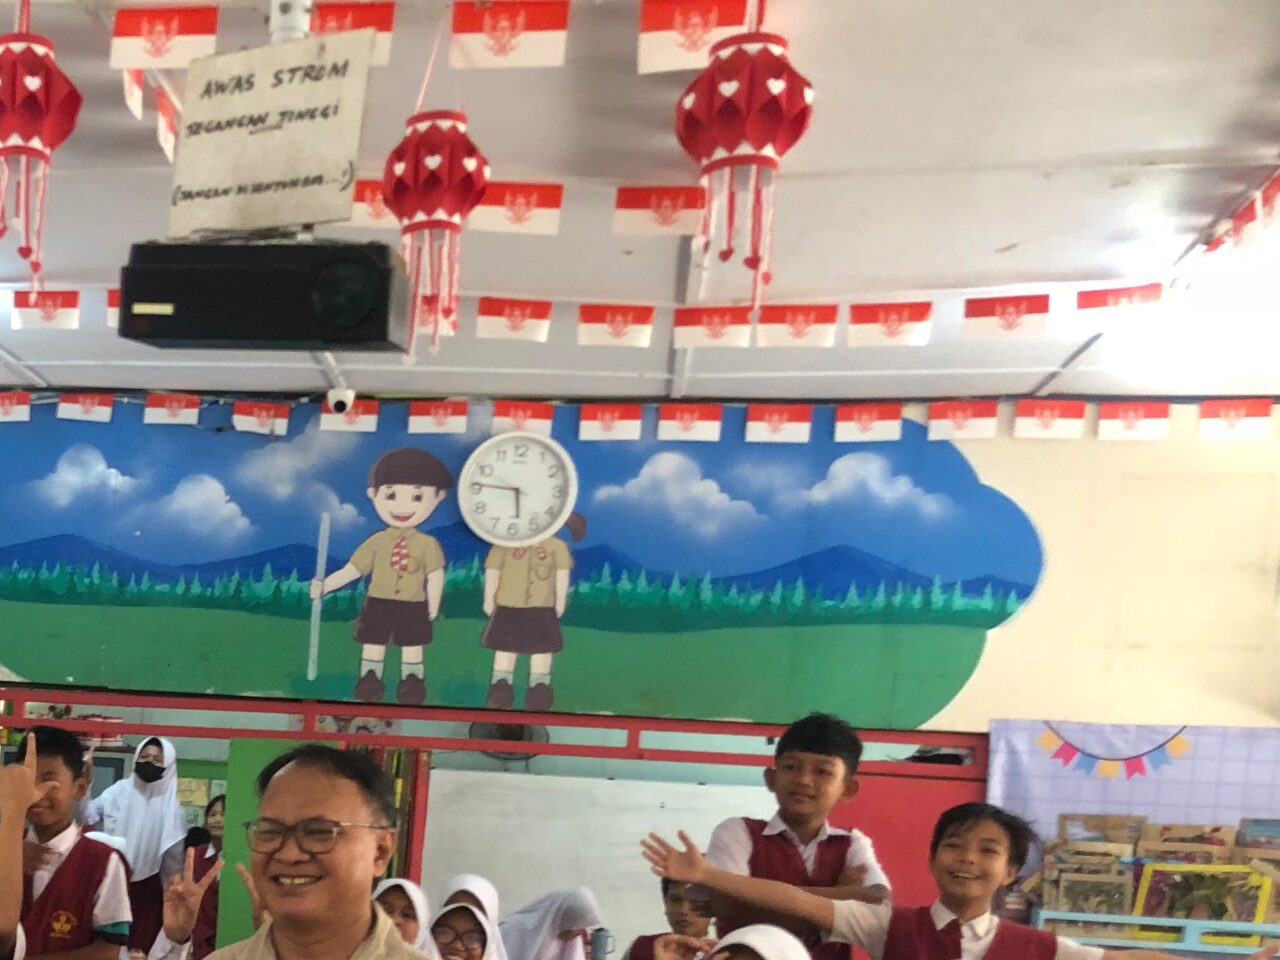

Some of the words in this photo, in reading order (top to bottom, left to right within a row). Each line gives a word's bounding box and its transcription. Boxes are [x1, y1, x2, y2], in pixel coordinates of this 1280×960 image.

[200, 73, 256, 100] AWAS
[271, 59, 349, 88] STROM
[496, 450, 507, 462] 11
[514, 444, 529, 458] 12
[479, 464, 494, 477] 10
[548, 465, 560, 478] 2
[471, 482, 482, 495] 9
[552, 485, 563, 499] 3
[474, 501, 486, 514] 8
[544, 506, 554, 517] 4
[490, 517, 500, 529] 7
[507, 523, 519, 536] 6
[528, 517, 539, 532] 5
